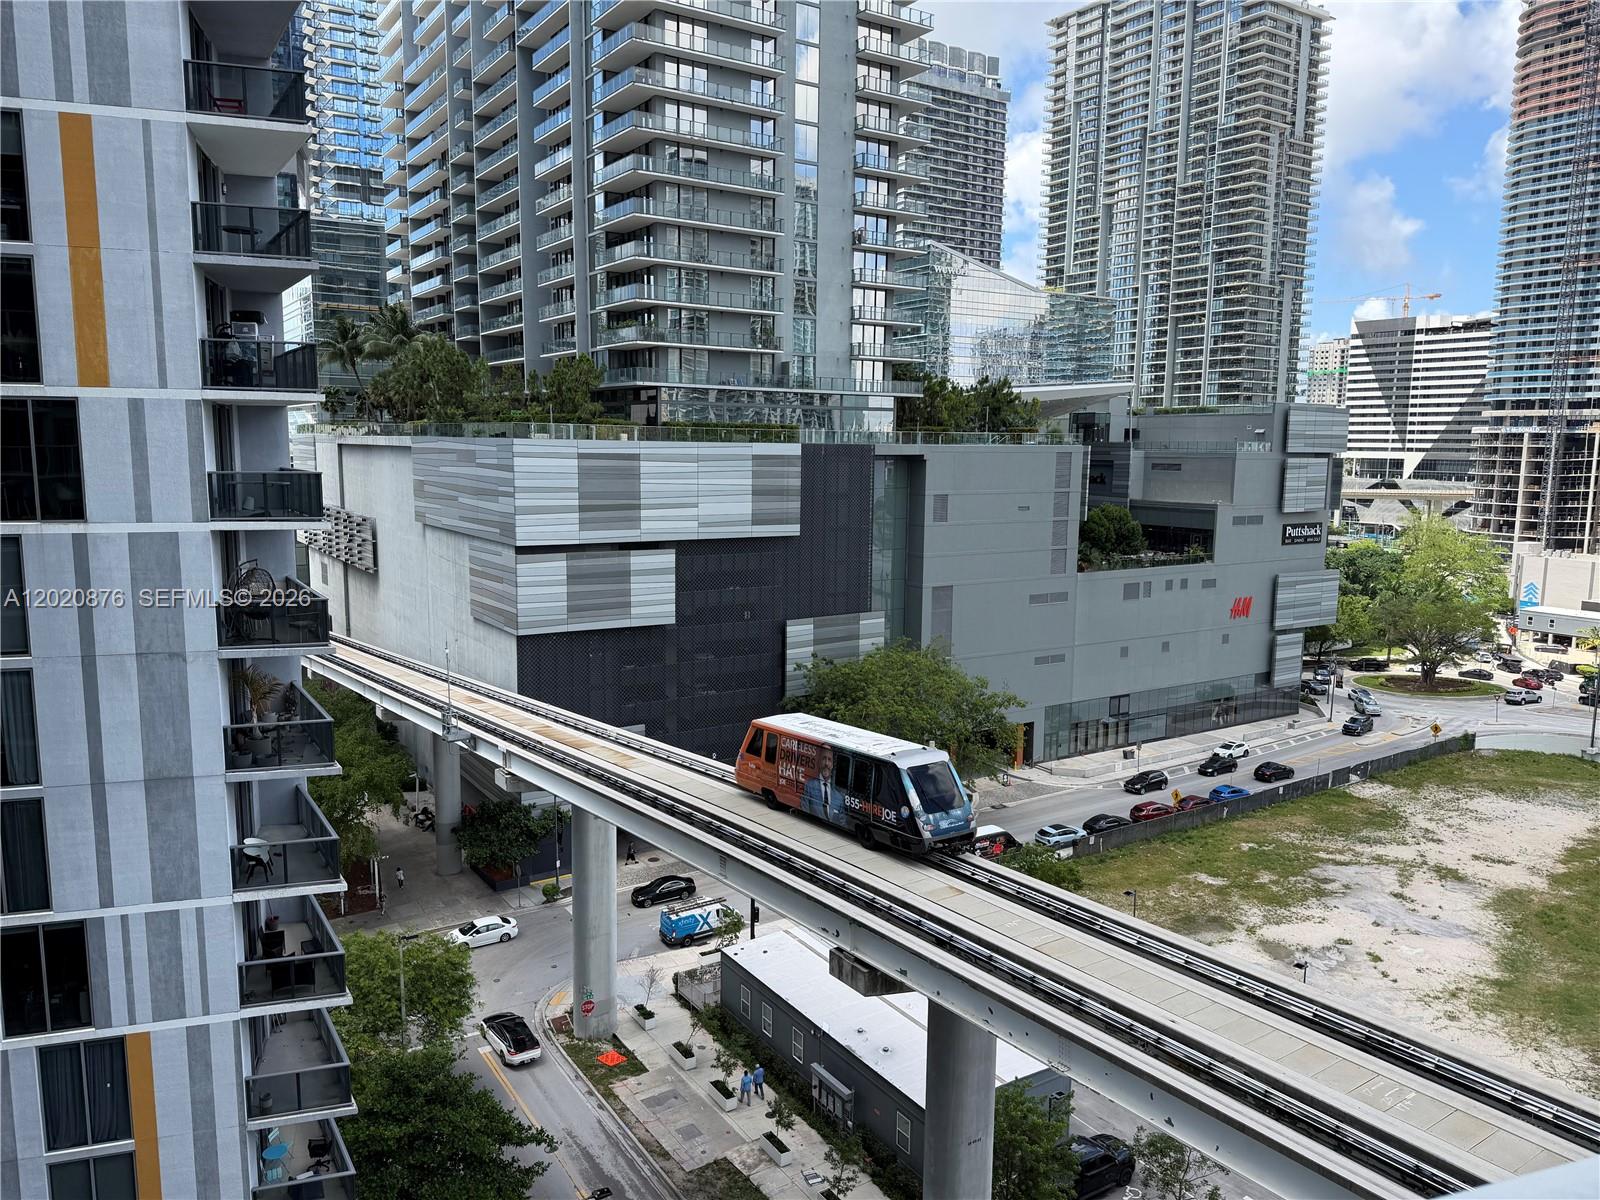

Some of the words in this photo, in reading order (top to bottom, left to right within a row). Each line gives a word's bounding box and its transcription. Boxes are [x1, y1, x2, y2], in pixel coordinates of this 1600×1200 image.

[1286, 524, 1321, 536] Puttshack
[779, 761, 806, 782] HATE
[844, 795, 897, 822] 855-HIREJOE
